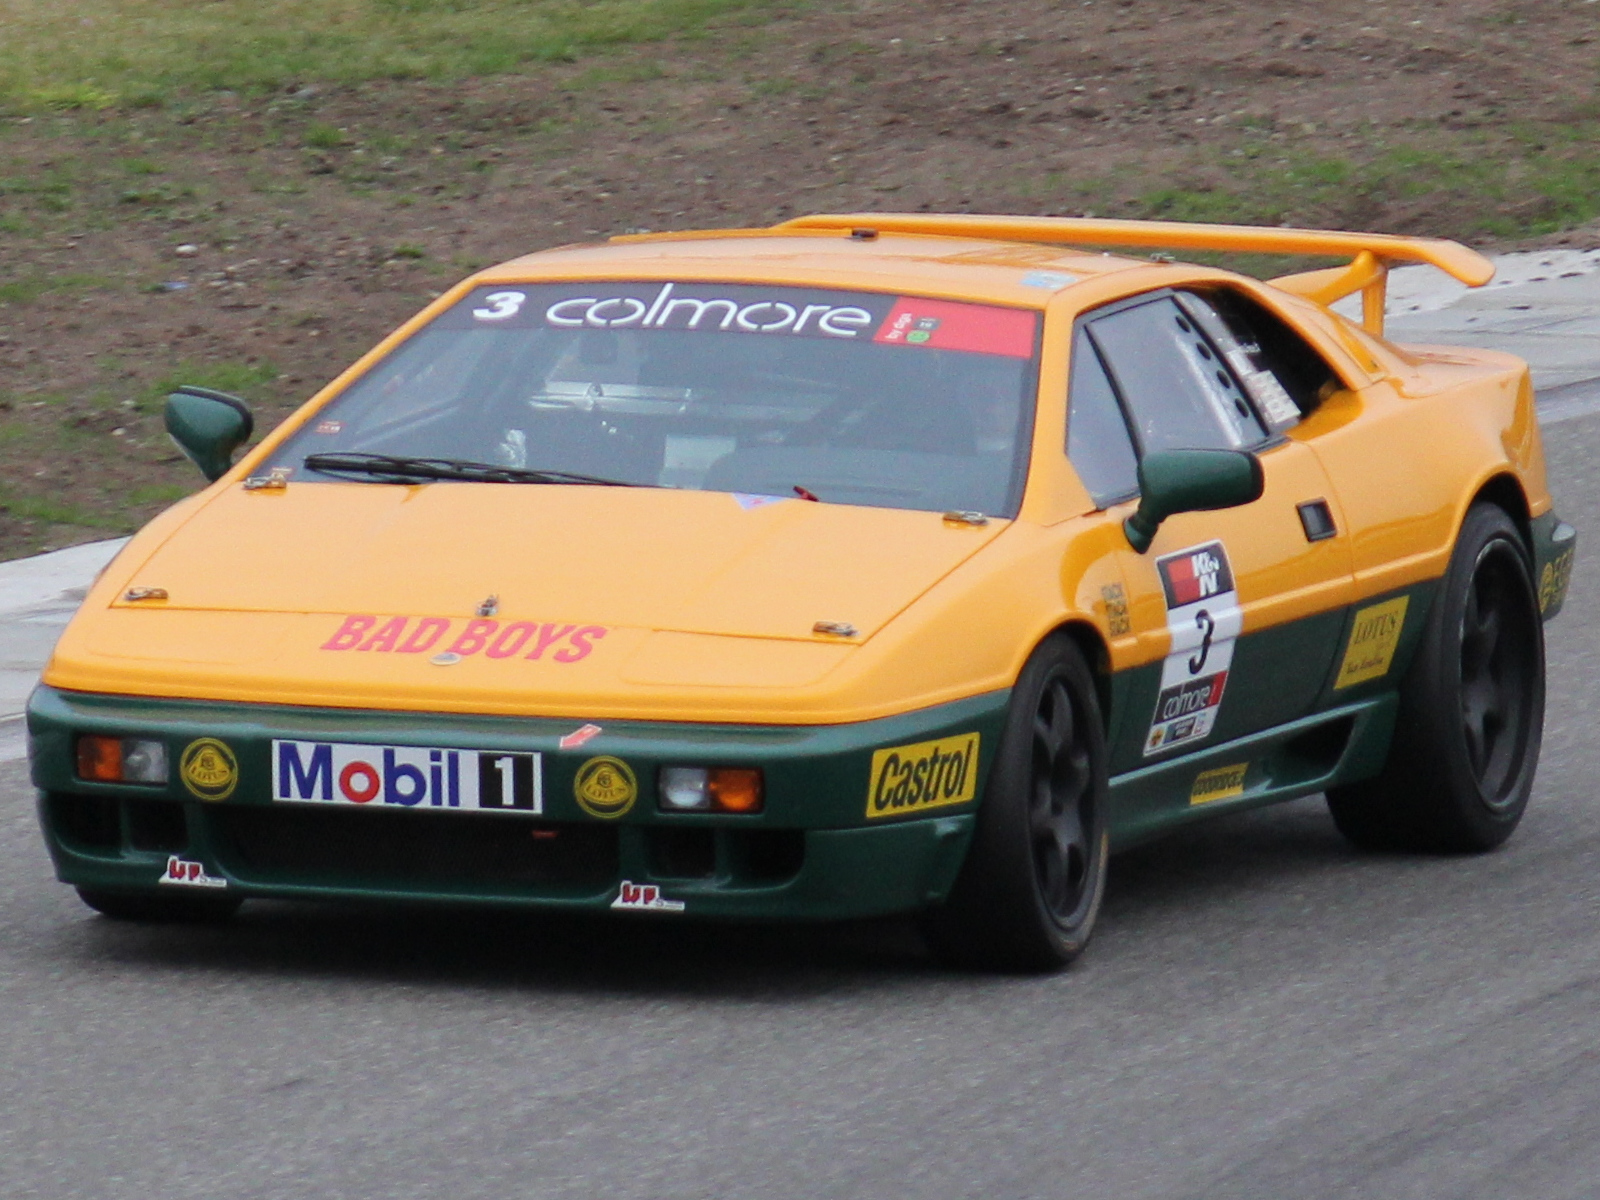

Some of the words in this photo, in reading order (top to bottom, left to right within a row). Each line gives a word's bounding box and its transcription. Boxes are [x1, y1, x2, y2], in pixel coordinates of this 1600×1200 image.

[472, 291, 527, 321] 3
[545, 283, 872, 337] colmore
[319, 614, 451, 654] BAD
[444, 618, 609, 664] BOYS
[1188, 608, 1215, 675] 3
[1353, 610, 1399, 646] LOTUS
[278, 741, 461, 807] Mobil
[494, 756, 515, 806] 1
[874, 739, 975, 811] Castrol
